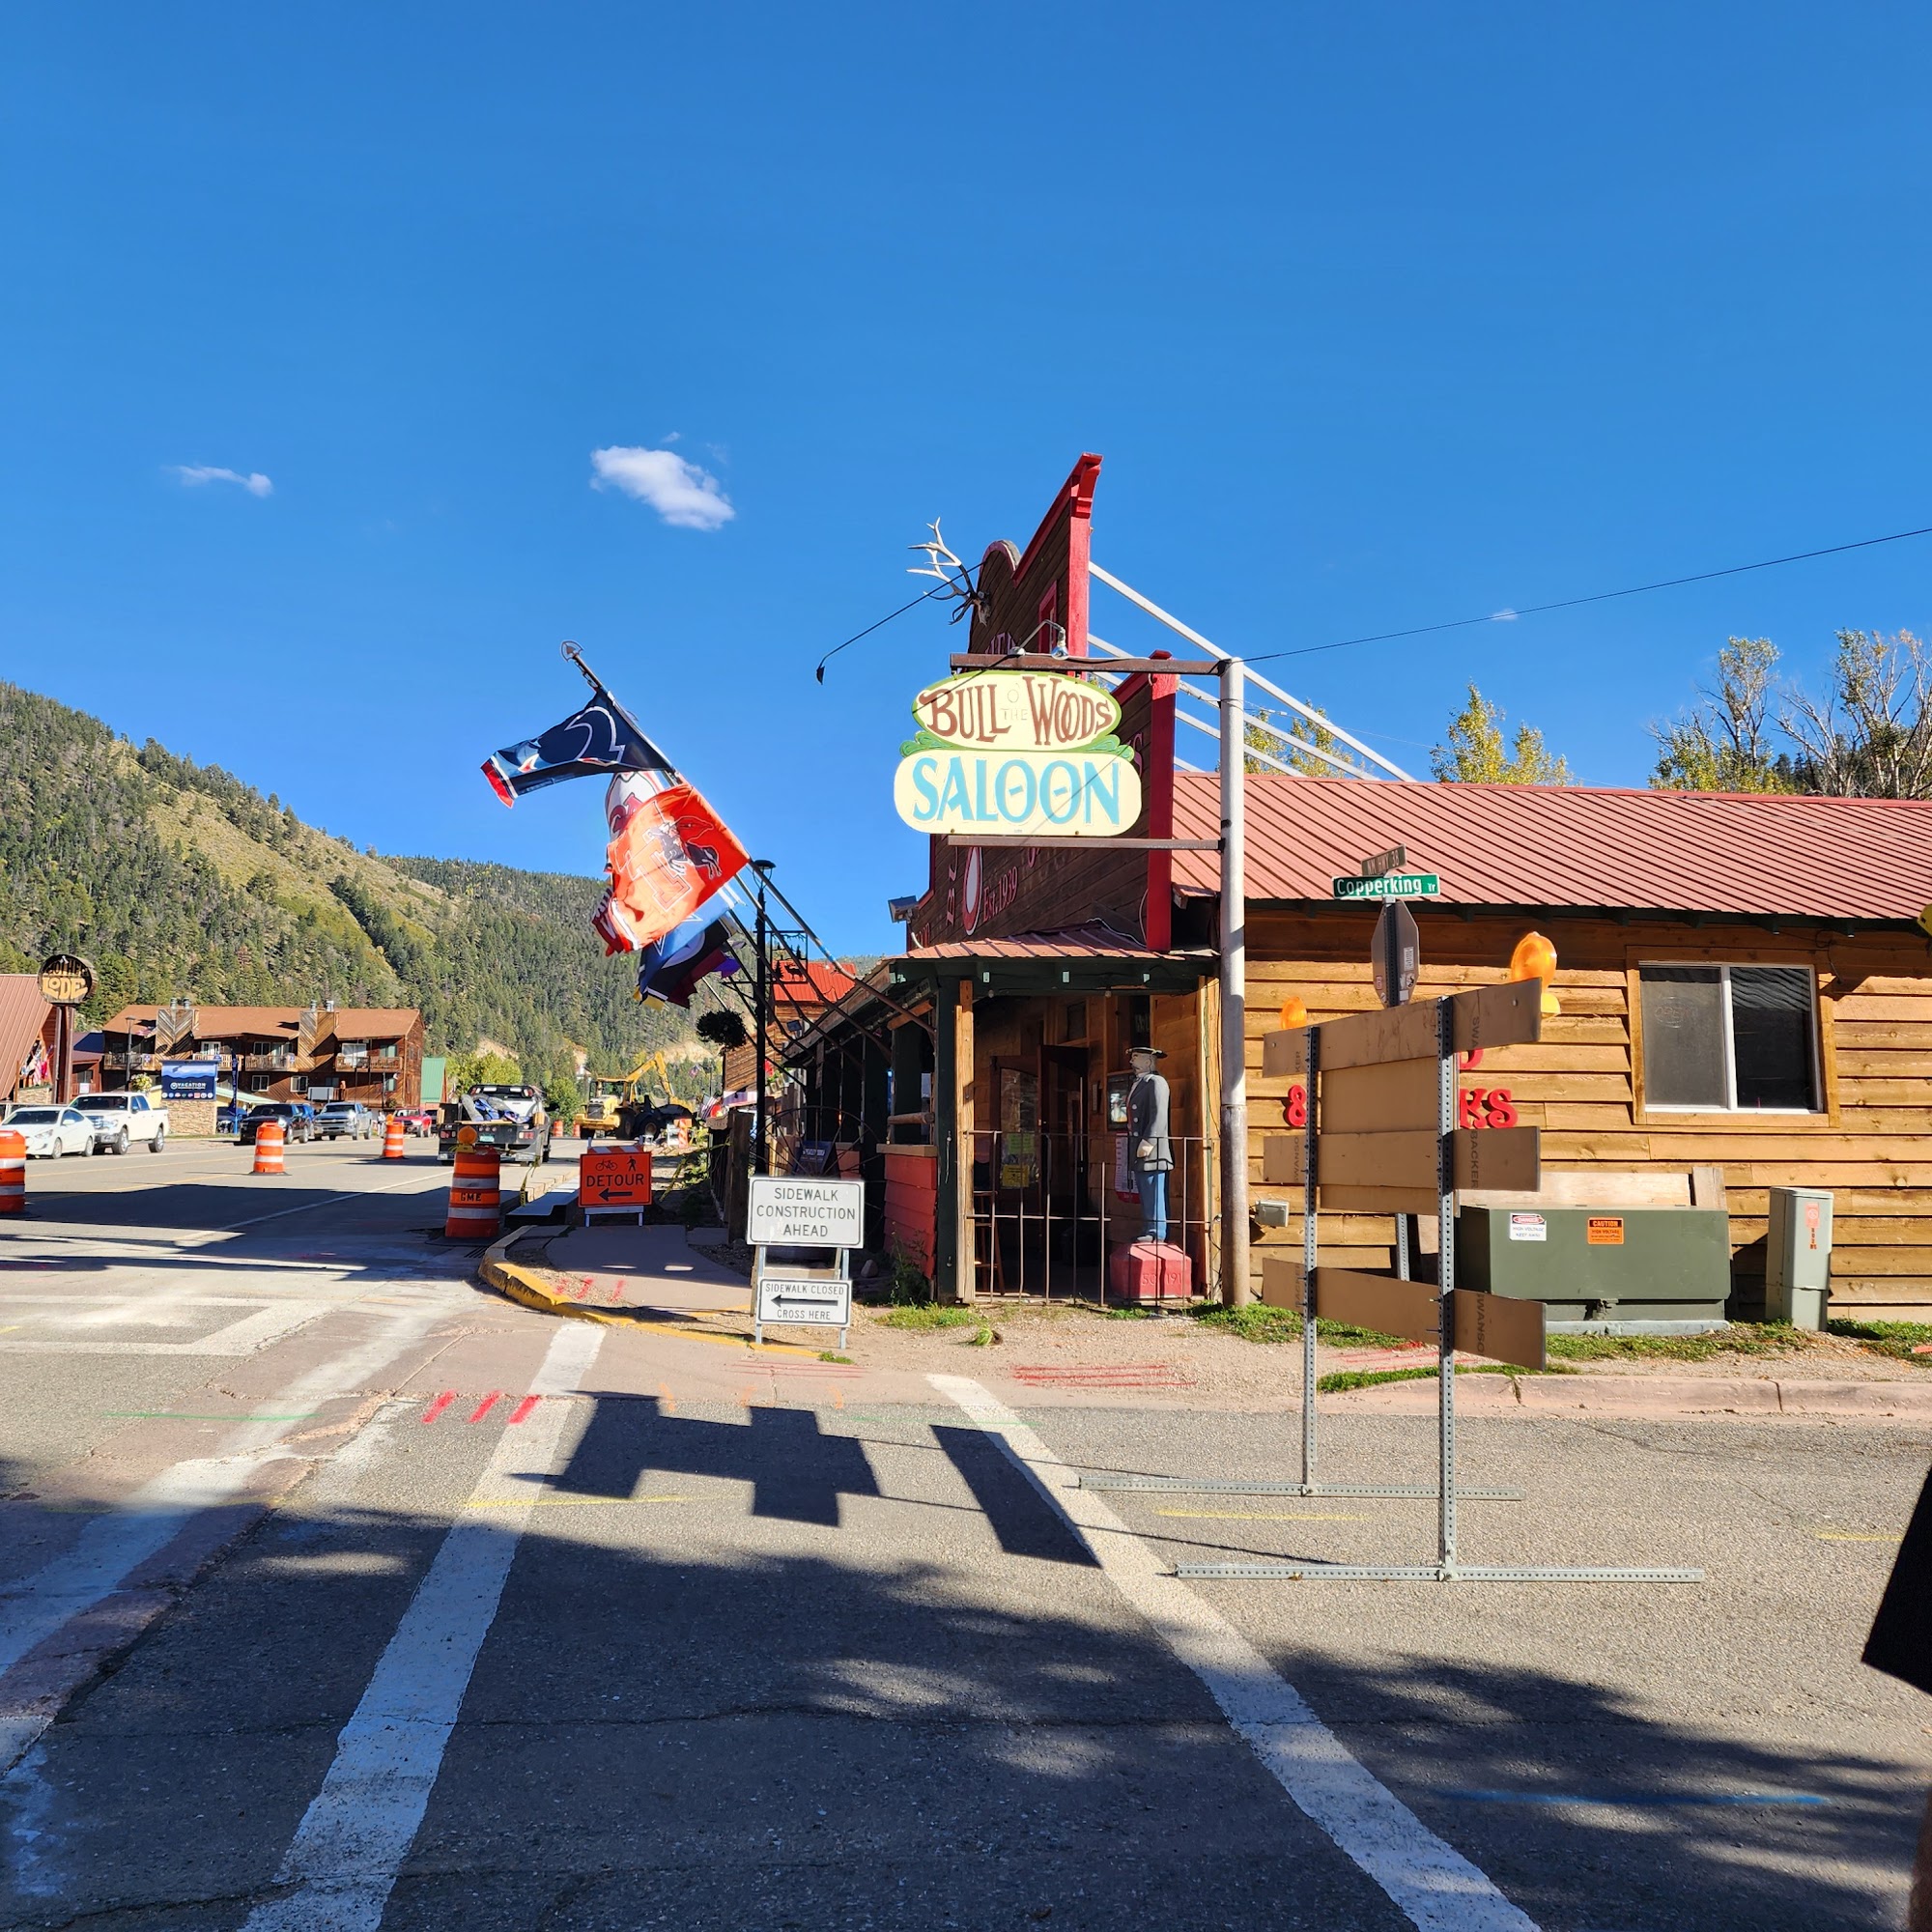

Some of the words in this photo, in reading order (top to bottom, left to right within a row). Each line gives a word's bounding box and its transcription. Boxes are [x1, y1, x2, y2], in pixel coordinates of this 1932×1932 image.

[919, 684, 1011, 743] BULL
[1000, 707, 1029, 721] THE
[1022, 676, 1113, 746] WOODS
[912, 755, 1121, 826] SALOON
[1391, 850, 1400, 867] 38
[1337, 876, 1423, 895] Copperking
[1428, 883, 1436, 892] Tr
[42, 977, 88, 1000] LODE
[1470, 1131, 1479, 1190] BACKER
[586, 1174, 644, 1187] DETOUR
[460, 1192, 482, 1202] GME
[774, 1187, 838, 1201] SIDEWALK
[756, 1205, 856, 1219] CONSTRUCTION
[782, 1224, 828, 1236] AHEAD
[765, 1283, 808, 1293] SIDEWALK
[810, 1285, 844, 1295] CLOSED
[777, 1309, 806, 1319] CROSS
[809, 1310, 831, 1321] HERE
